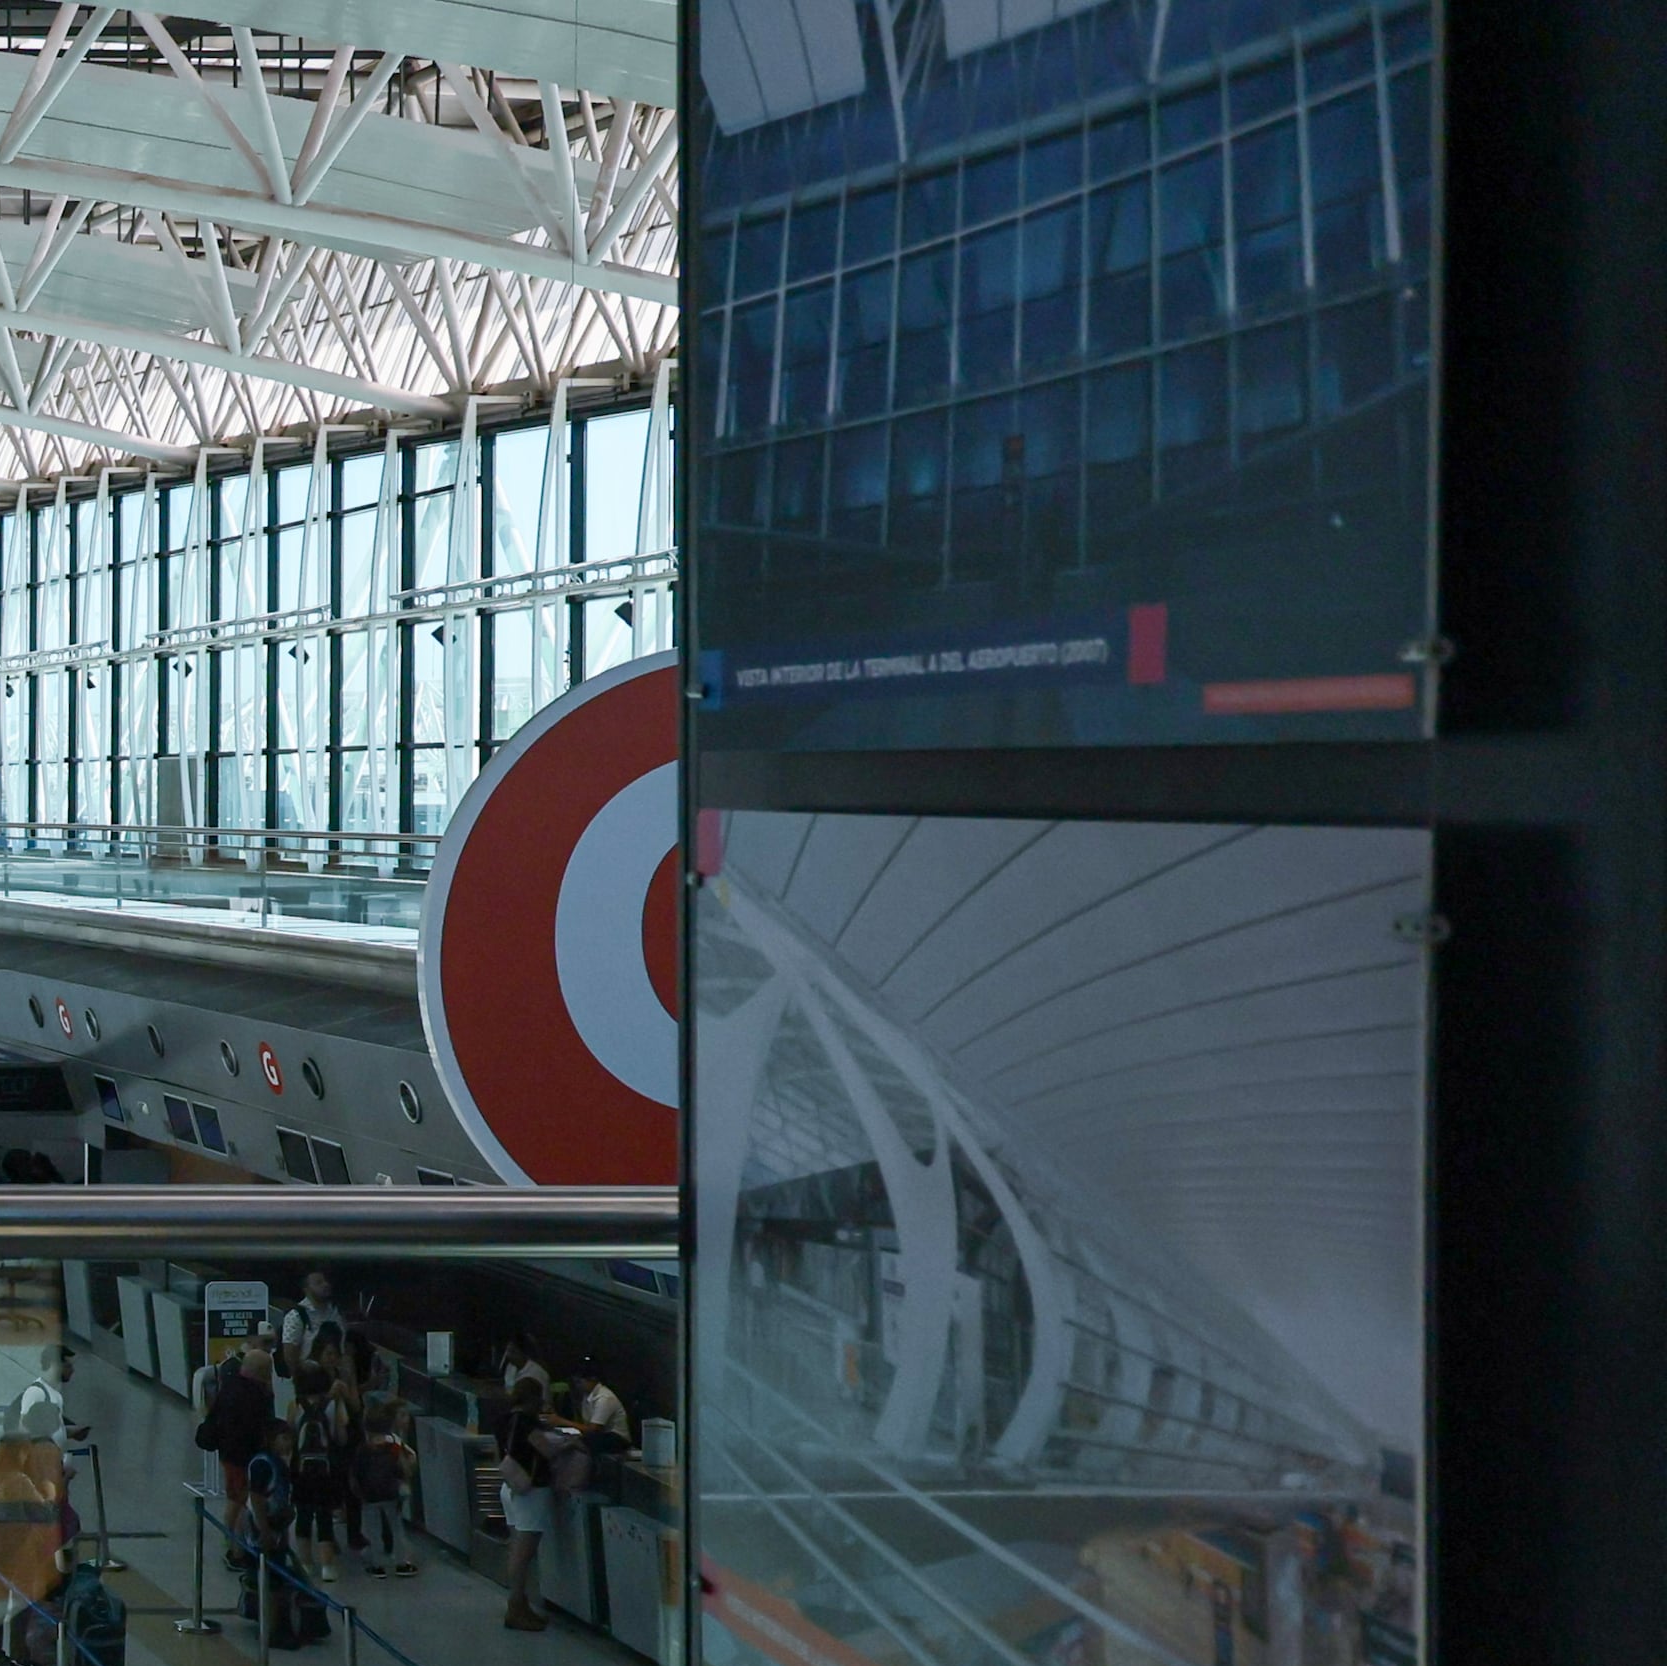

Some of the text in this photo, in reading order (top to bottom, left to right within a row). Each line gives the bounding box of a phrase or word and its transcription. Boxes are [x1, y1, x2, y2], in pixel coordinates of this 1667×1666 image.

[736, 668, 767, 688] VISTA
[59, 1004, 71, 1034] G
[262, 1051, 279, 1086] G
